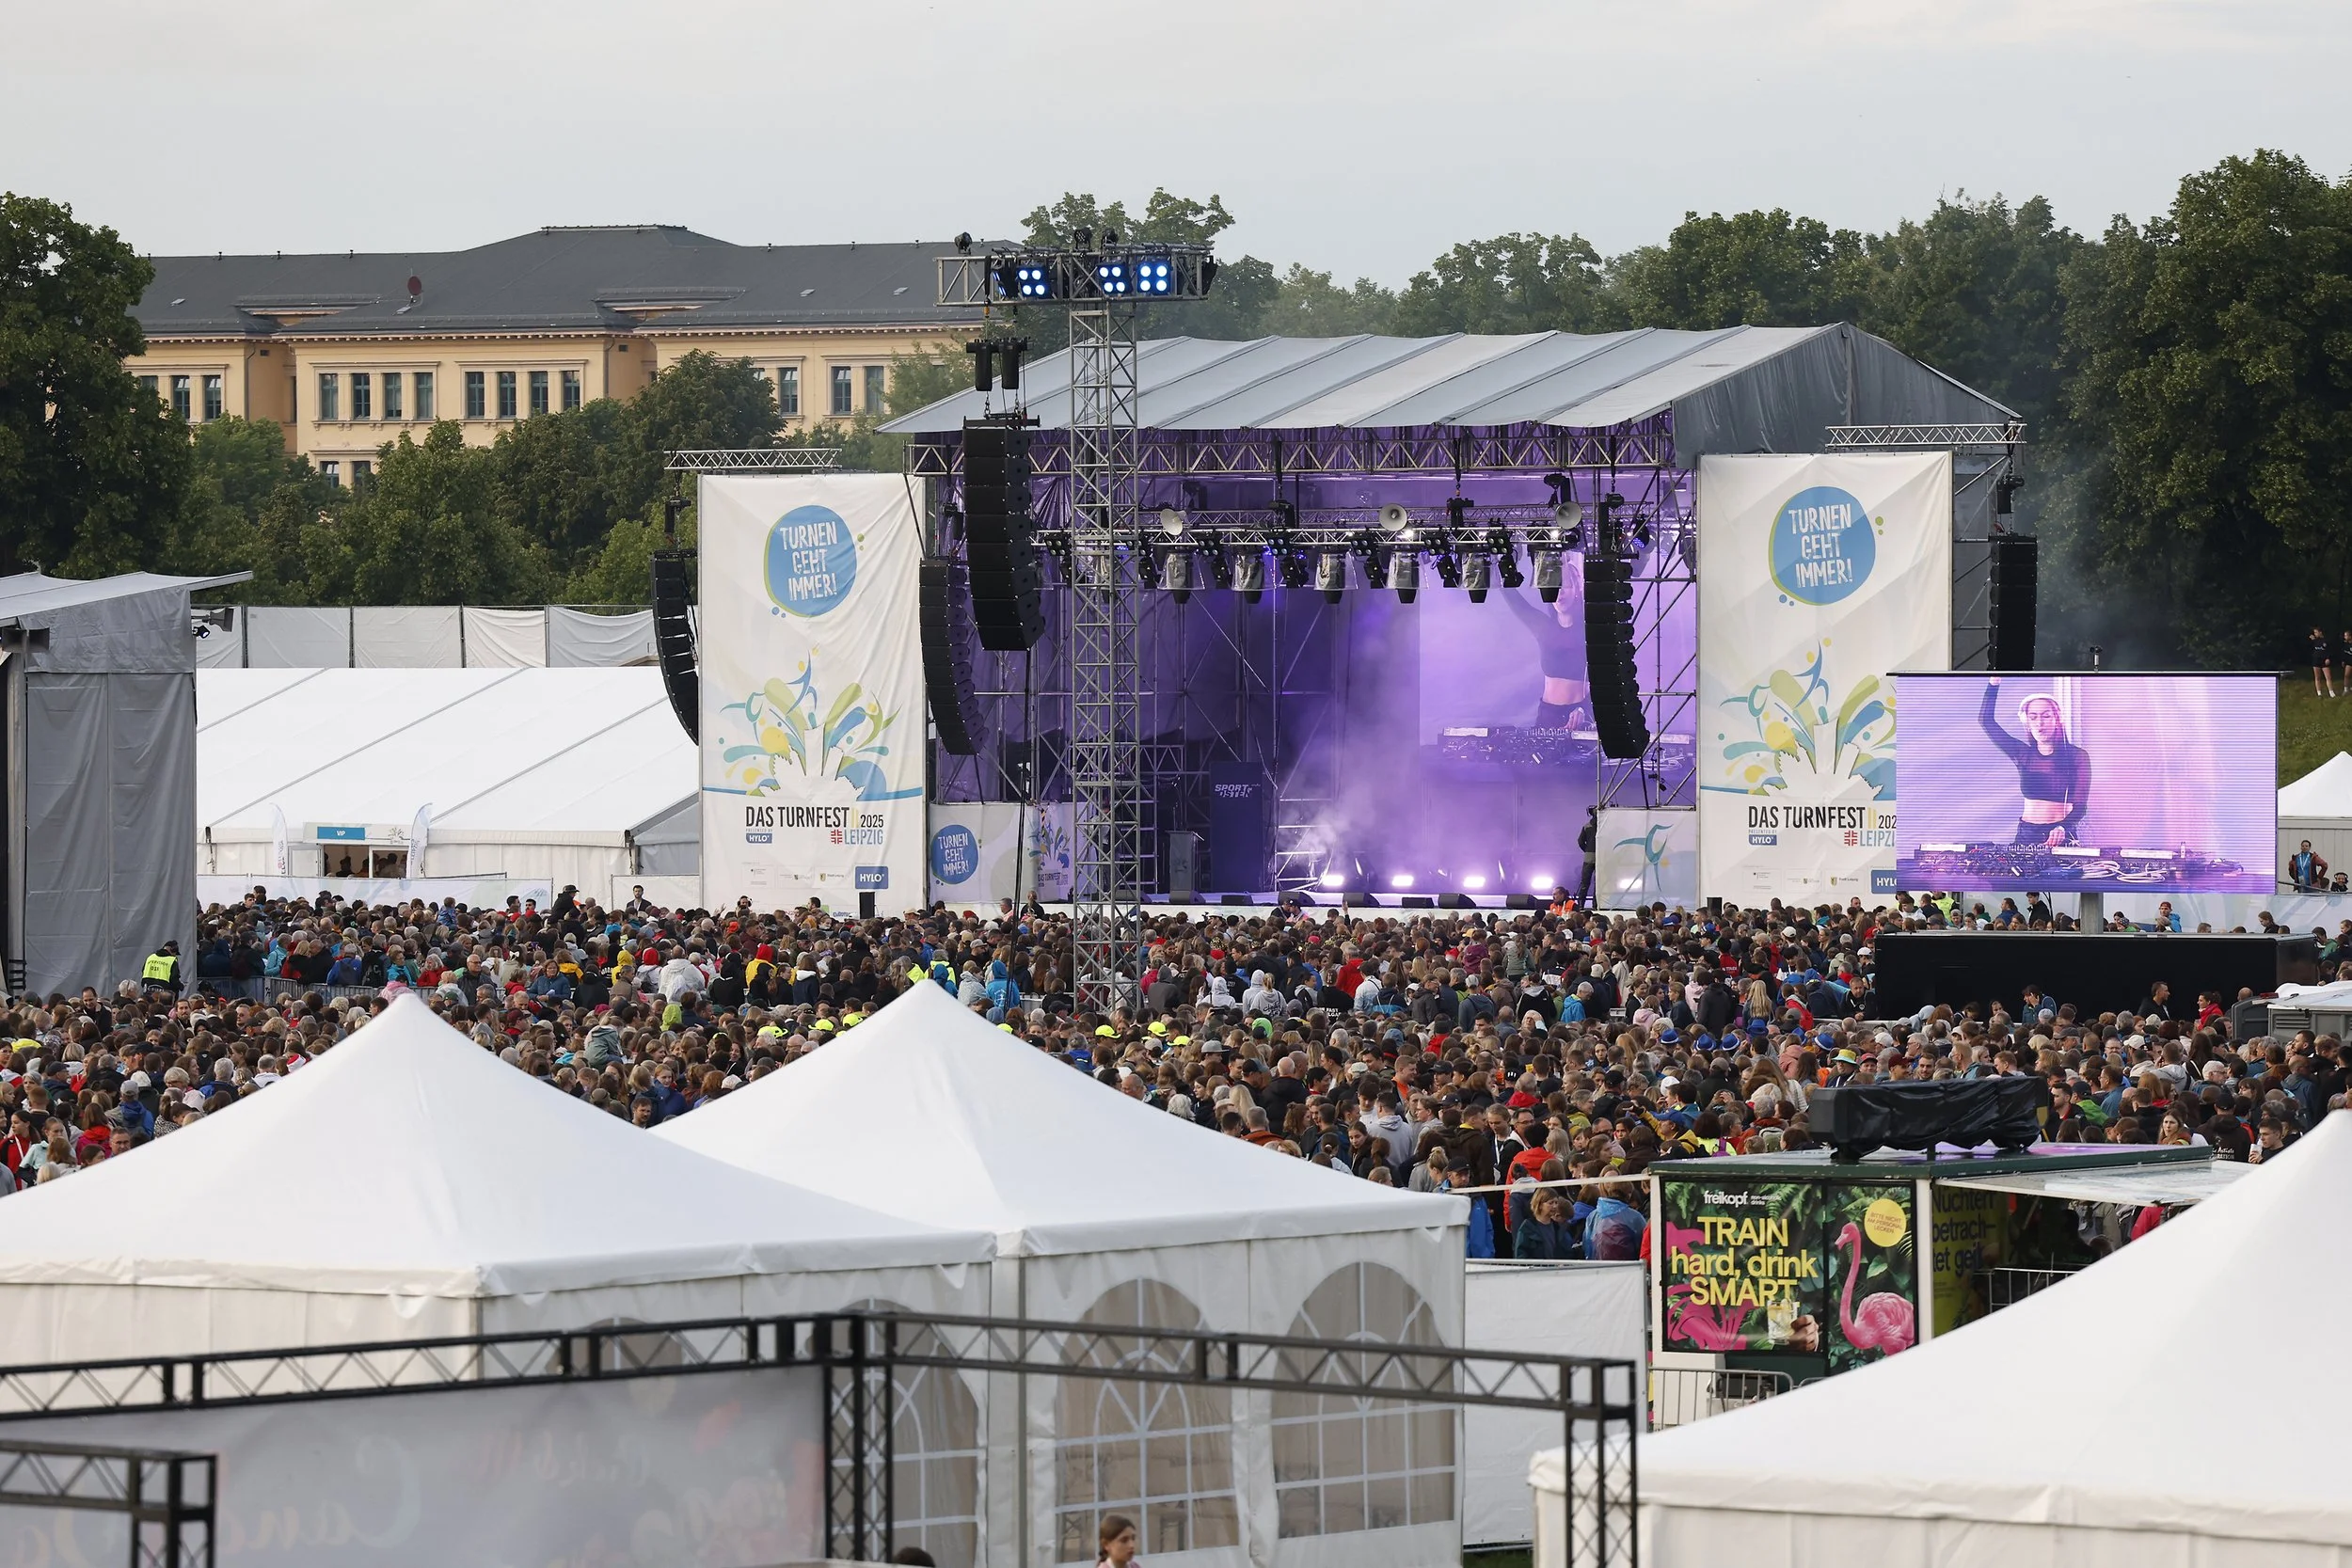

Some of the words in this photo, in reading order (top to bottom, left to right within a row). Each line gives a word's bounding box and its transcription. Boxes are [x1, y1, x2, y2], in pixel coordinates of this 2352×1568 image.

[1788, 502, 1851, 535] TURNEN
[780, 521, 837, 550] TURNEN
[1801, 531, 1842, 560] GEHT
[791, 548, 828, 576] GEHT
[1794, 557, 1853, 589] IMMER!
[788, 573, 837, 602] IMMER!
[1215, 784, 1249, 792] SPORT
[746, 806, 773, 828] DAS
[778, 806, 850, 828] TURNFEST
[860, 815, 884, 829] 2025
[1748, 806, 1779, 829] DAS
[1783, 807, 1866, 829] TURNFEST
[1878, 816, 1897, 829] 202
[844, 830, 883, 845] LEIPZIG
[938, 832, 968, 849] TURNEN
[1860, 831, 1895, 847] LEIPZI
[945, 847, 964, 862] GEHT
[860, 873, 882, 882] HYLO
[943, 861, 969, 876] IMMER!
[1704, 1190, 1748, 1208] freikopf
[1697, 1216, 1788, 1246] TRAIN
[1671, 1246, 1741, 1280] hard,
[1747, 1249, 1819, 1278] drink
